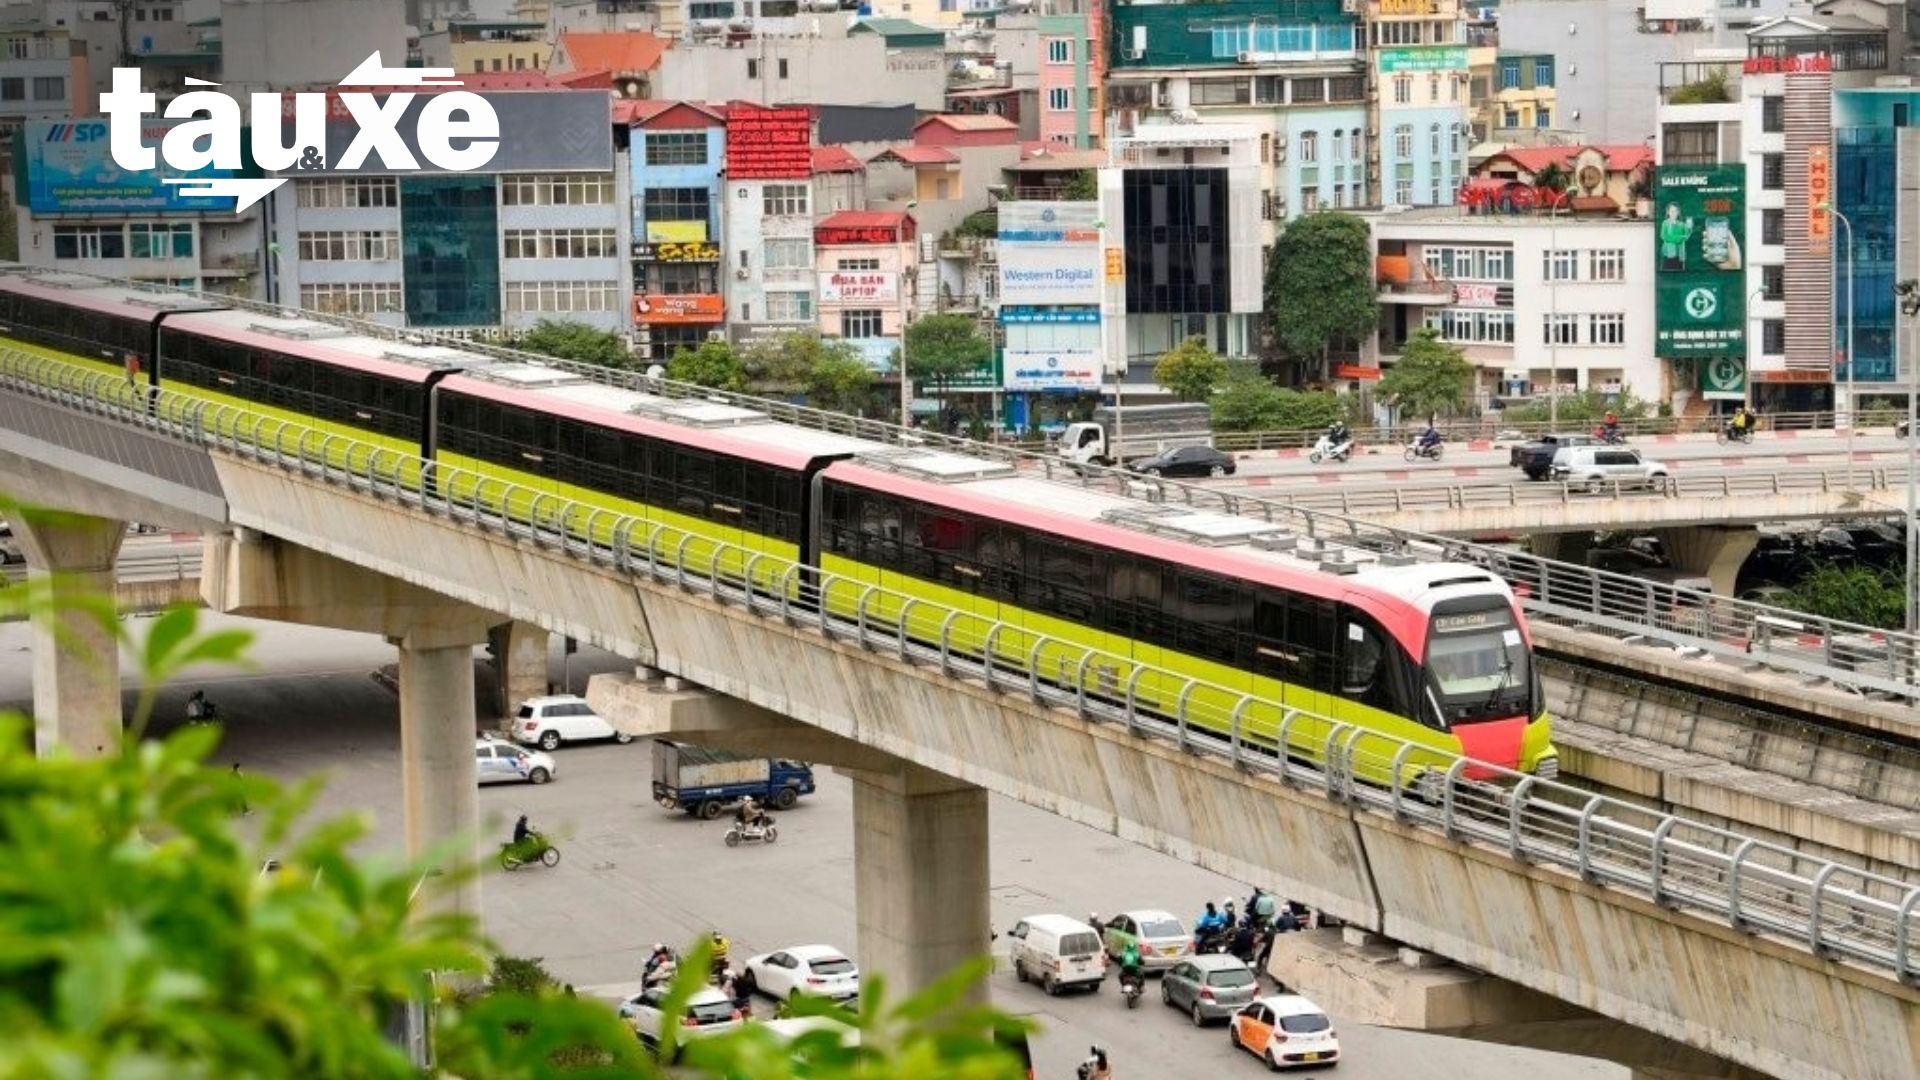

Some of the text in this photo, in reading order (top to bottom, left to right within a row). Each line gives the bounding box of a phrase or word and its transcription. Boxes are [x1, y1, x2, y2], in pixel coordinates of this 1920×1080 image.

[1811, 162, 1826, 234] HOTEL
[831, 274, 857, 285] MUA
[1004, 268, 1093, 283] Western Digital
[840, 287, 877, 297] LAPTOP
